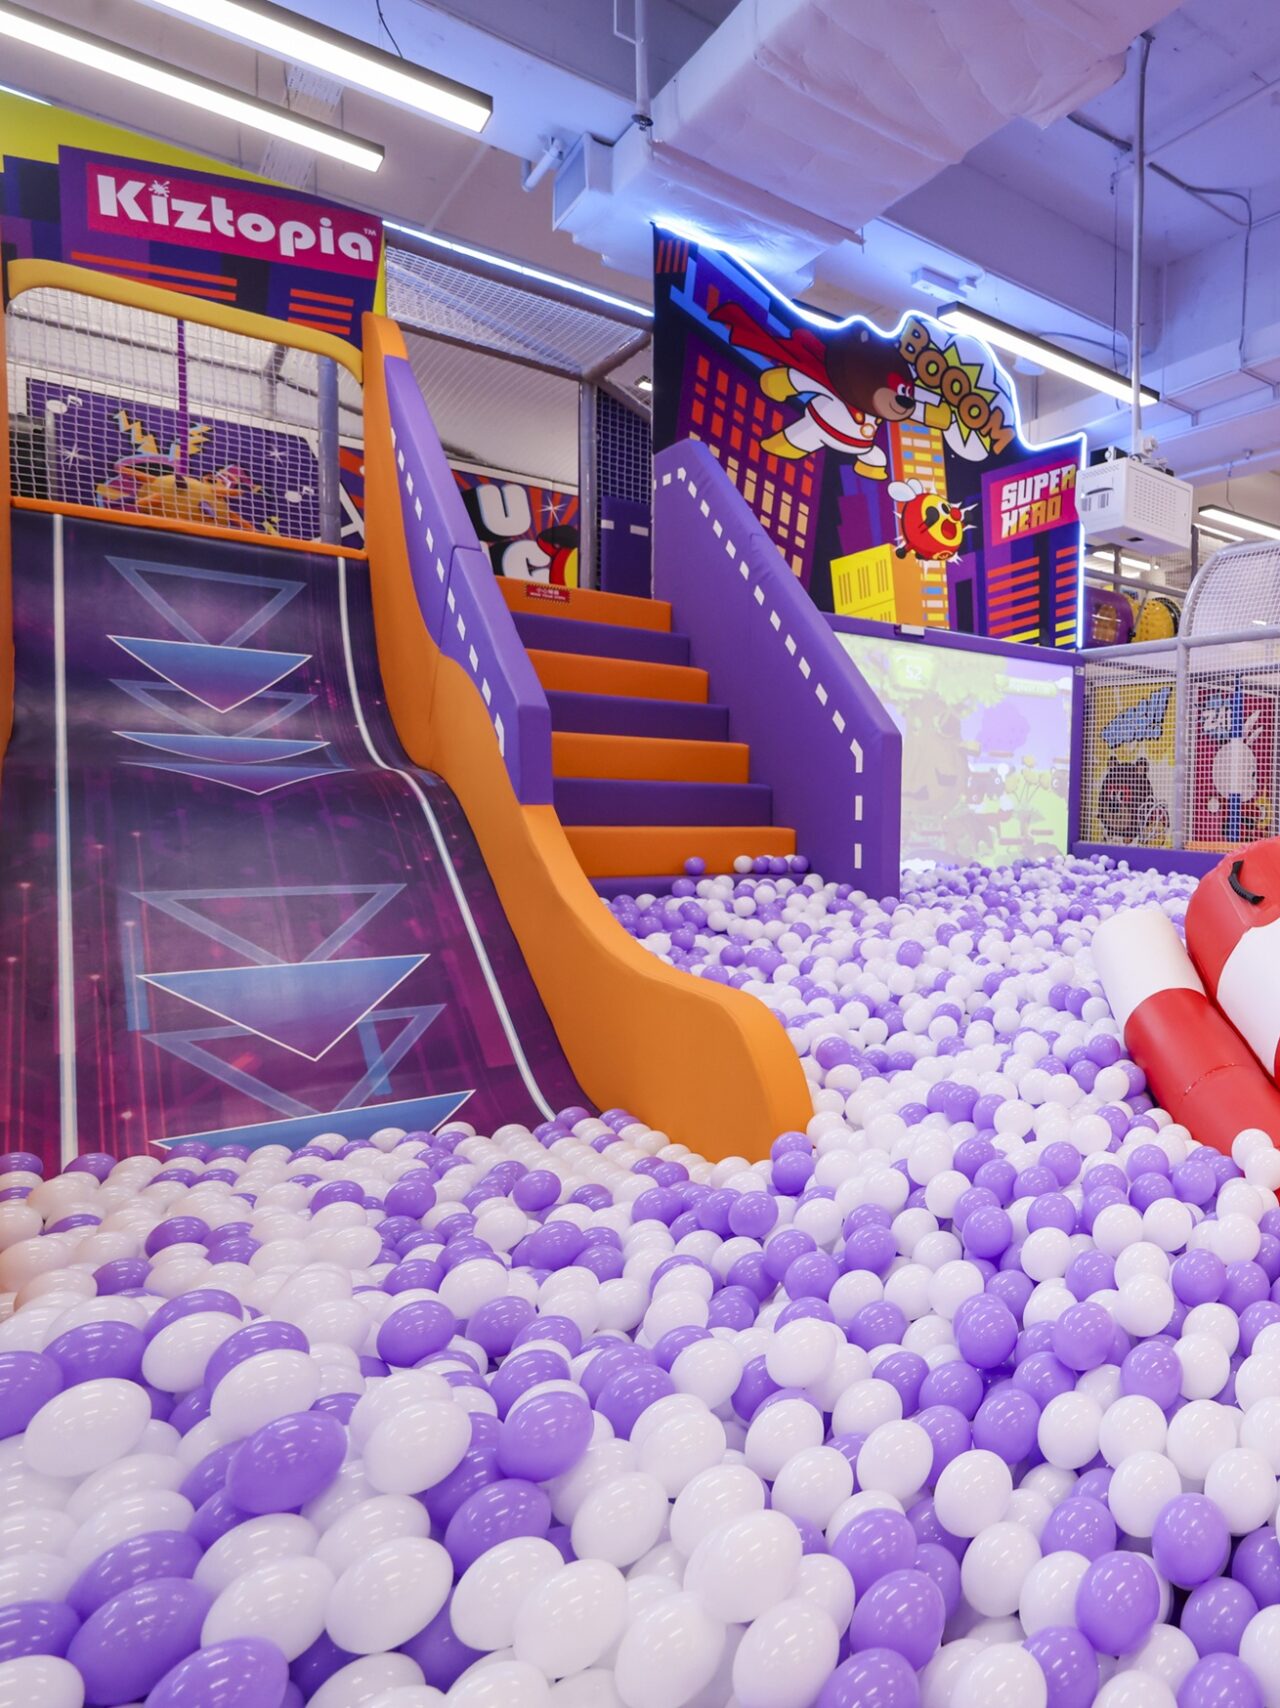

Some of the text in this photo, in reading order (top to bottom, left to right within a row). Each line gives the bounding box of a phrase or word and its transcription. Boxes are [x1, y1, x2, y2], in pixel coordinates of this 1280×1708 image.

[97, 174, 374, 262] Kiztopia
[901, 318, 1016, 455] BOOOM
[1000, 495, 1062, 540] HERO
[1001, 463, 1077, 511] SUPER
